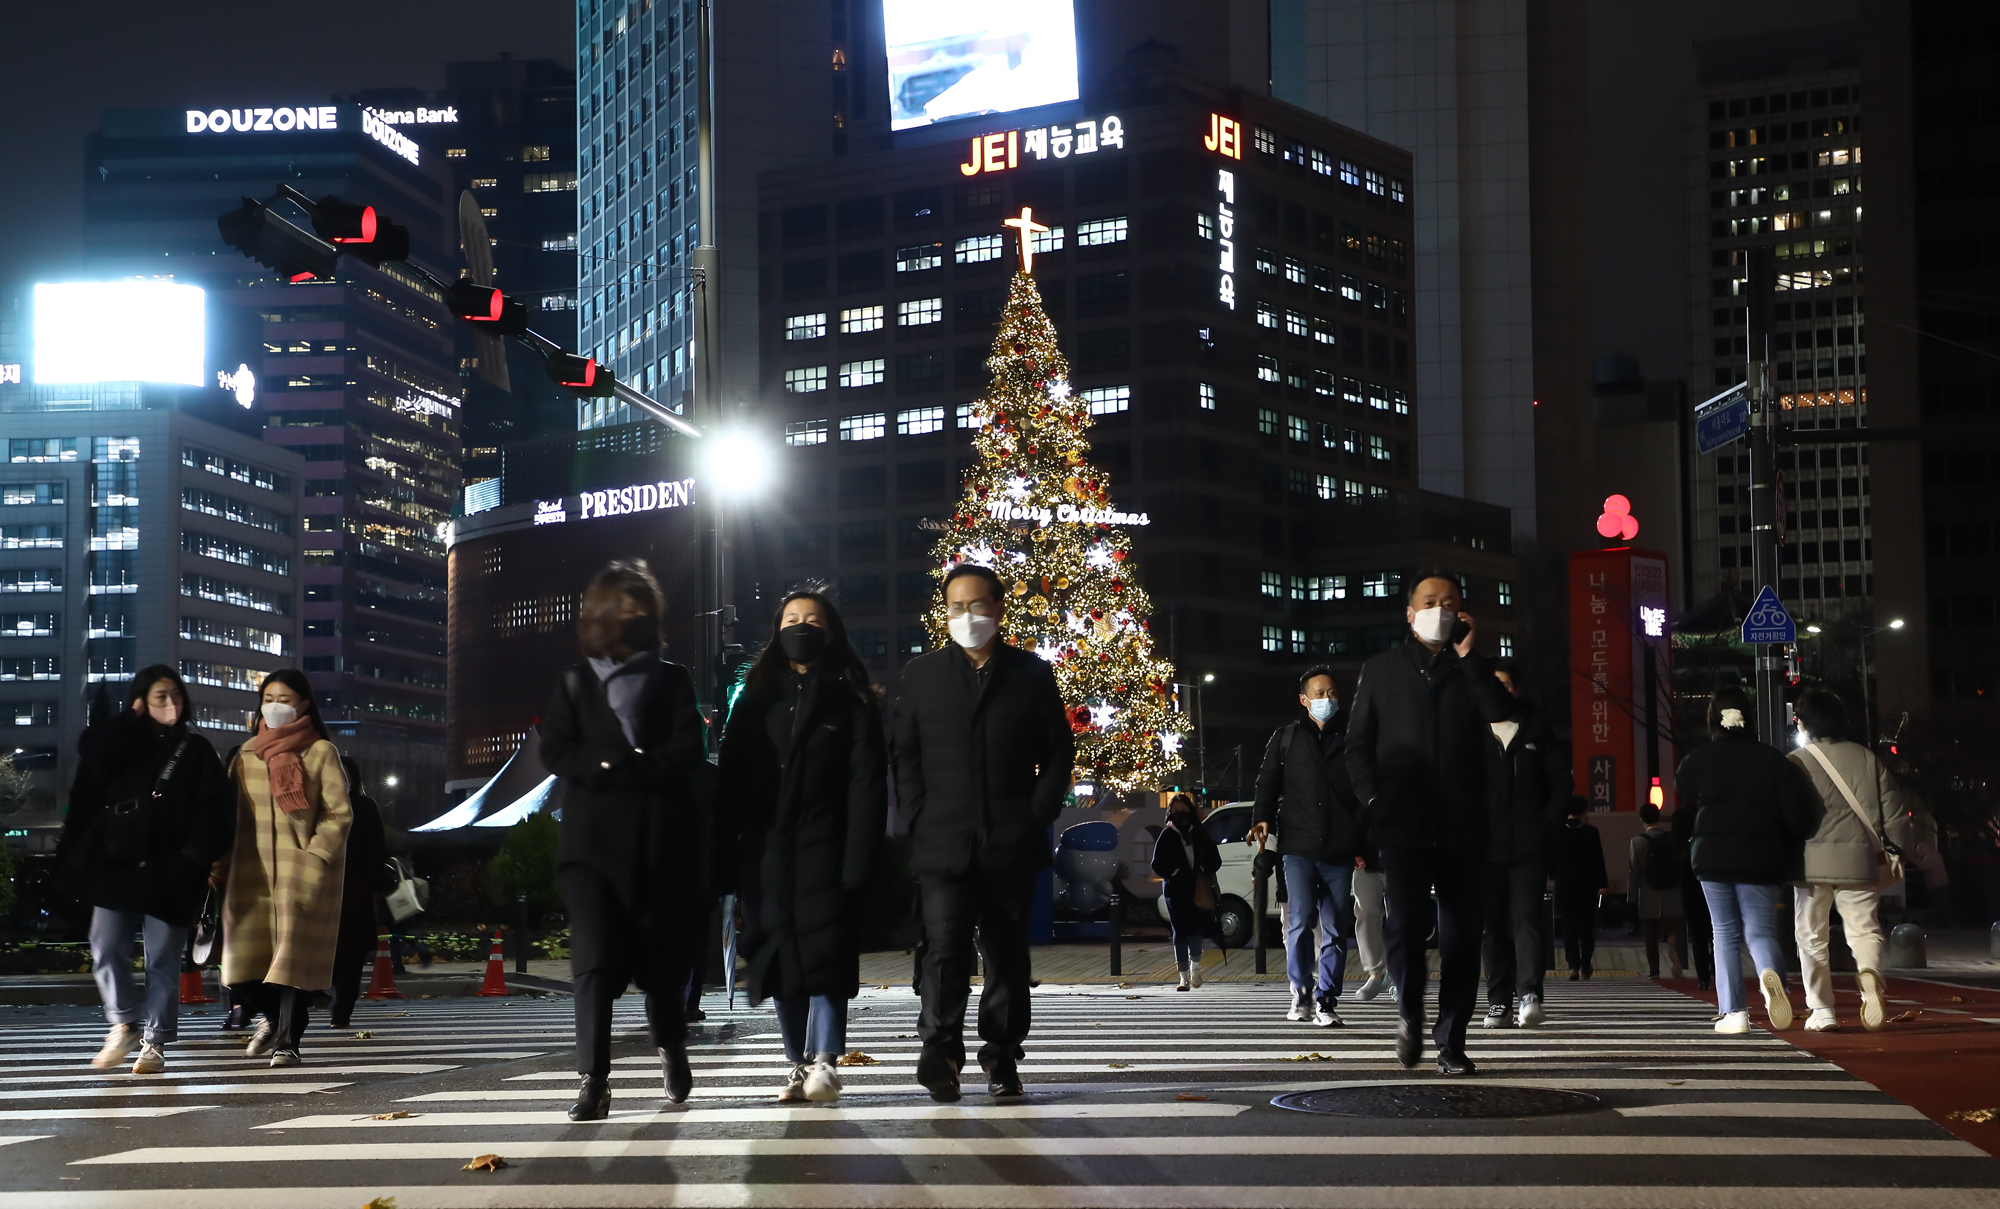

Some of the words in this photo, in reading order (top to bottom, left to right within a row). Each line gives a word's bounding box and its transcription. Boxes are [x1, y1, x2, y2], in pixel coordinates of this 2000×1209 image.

[186, 106, 337, 133] DOUZONE
[416, 106, 459, 123] Bank
[362, 109, 420, 167] DOUZONE
[960, 131, 1018, 176] JEI
[1024, 115, 1124, 160] 재능교육
[1204, 113, 1241, 160] JEI
[1218, 168, 1234, 311] 재능교육
[986, 501, 1053, 528] Merry
[1056, 503, 1151, 526] Christmas
[1750, 631, 1787, 641] 자전거횡단
[1592, 700, 1610, 743] 위한
